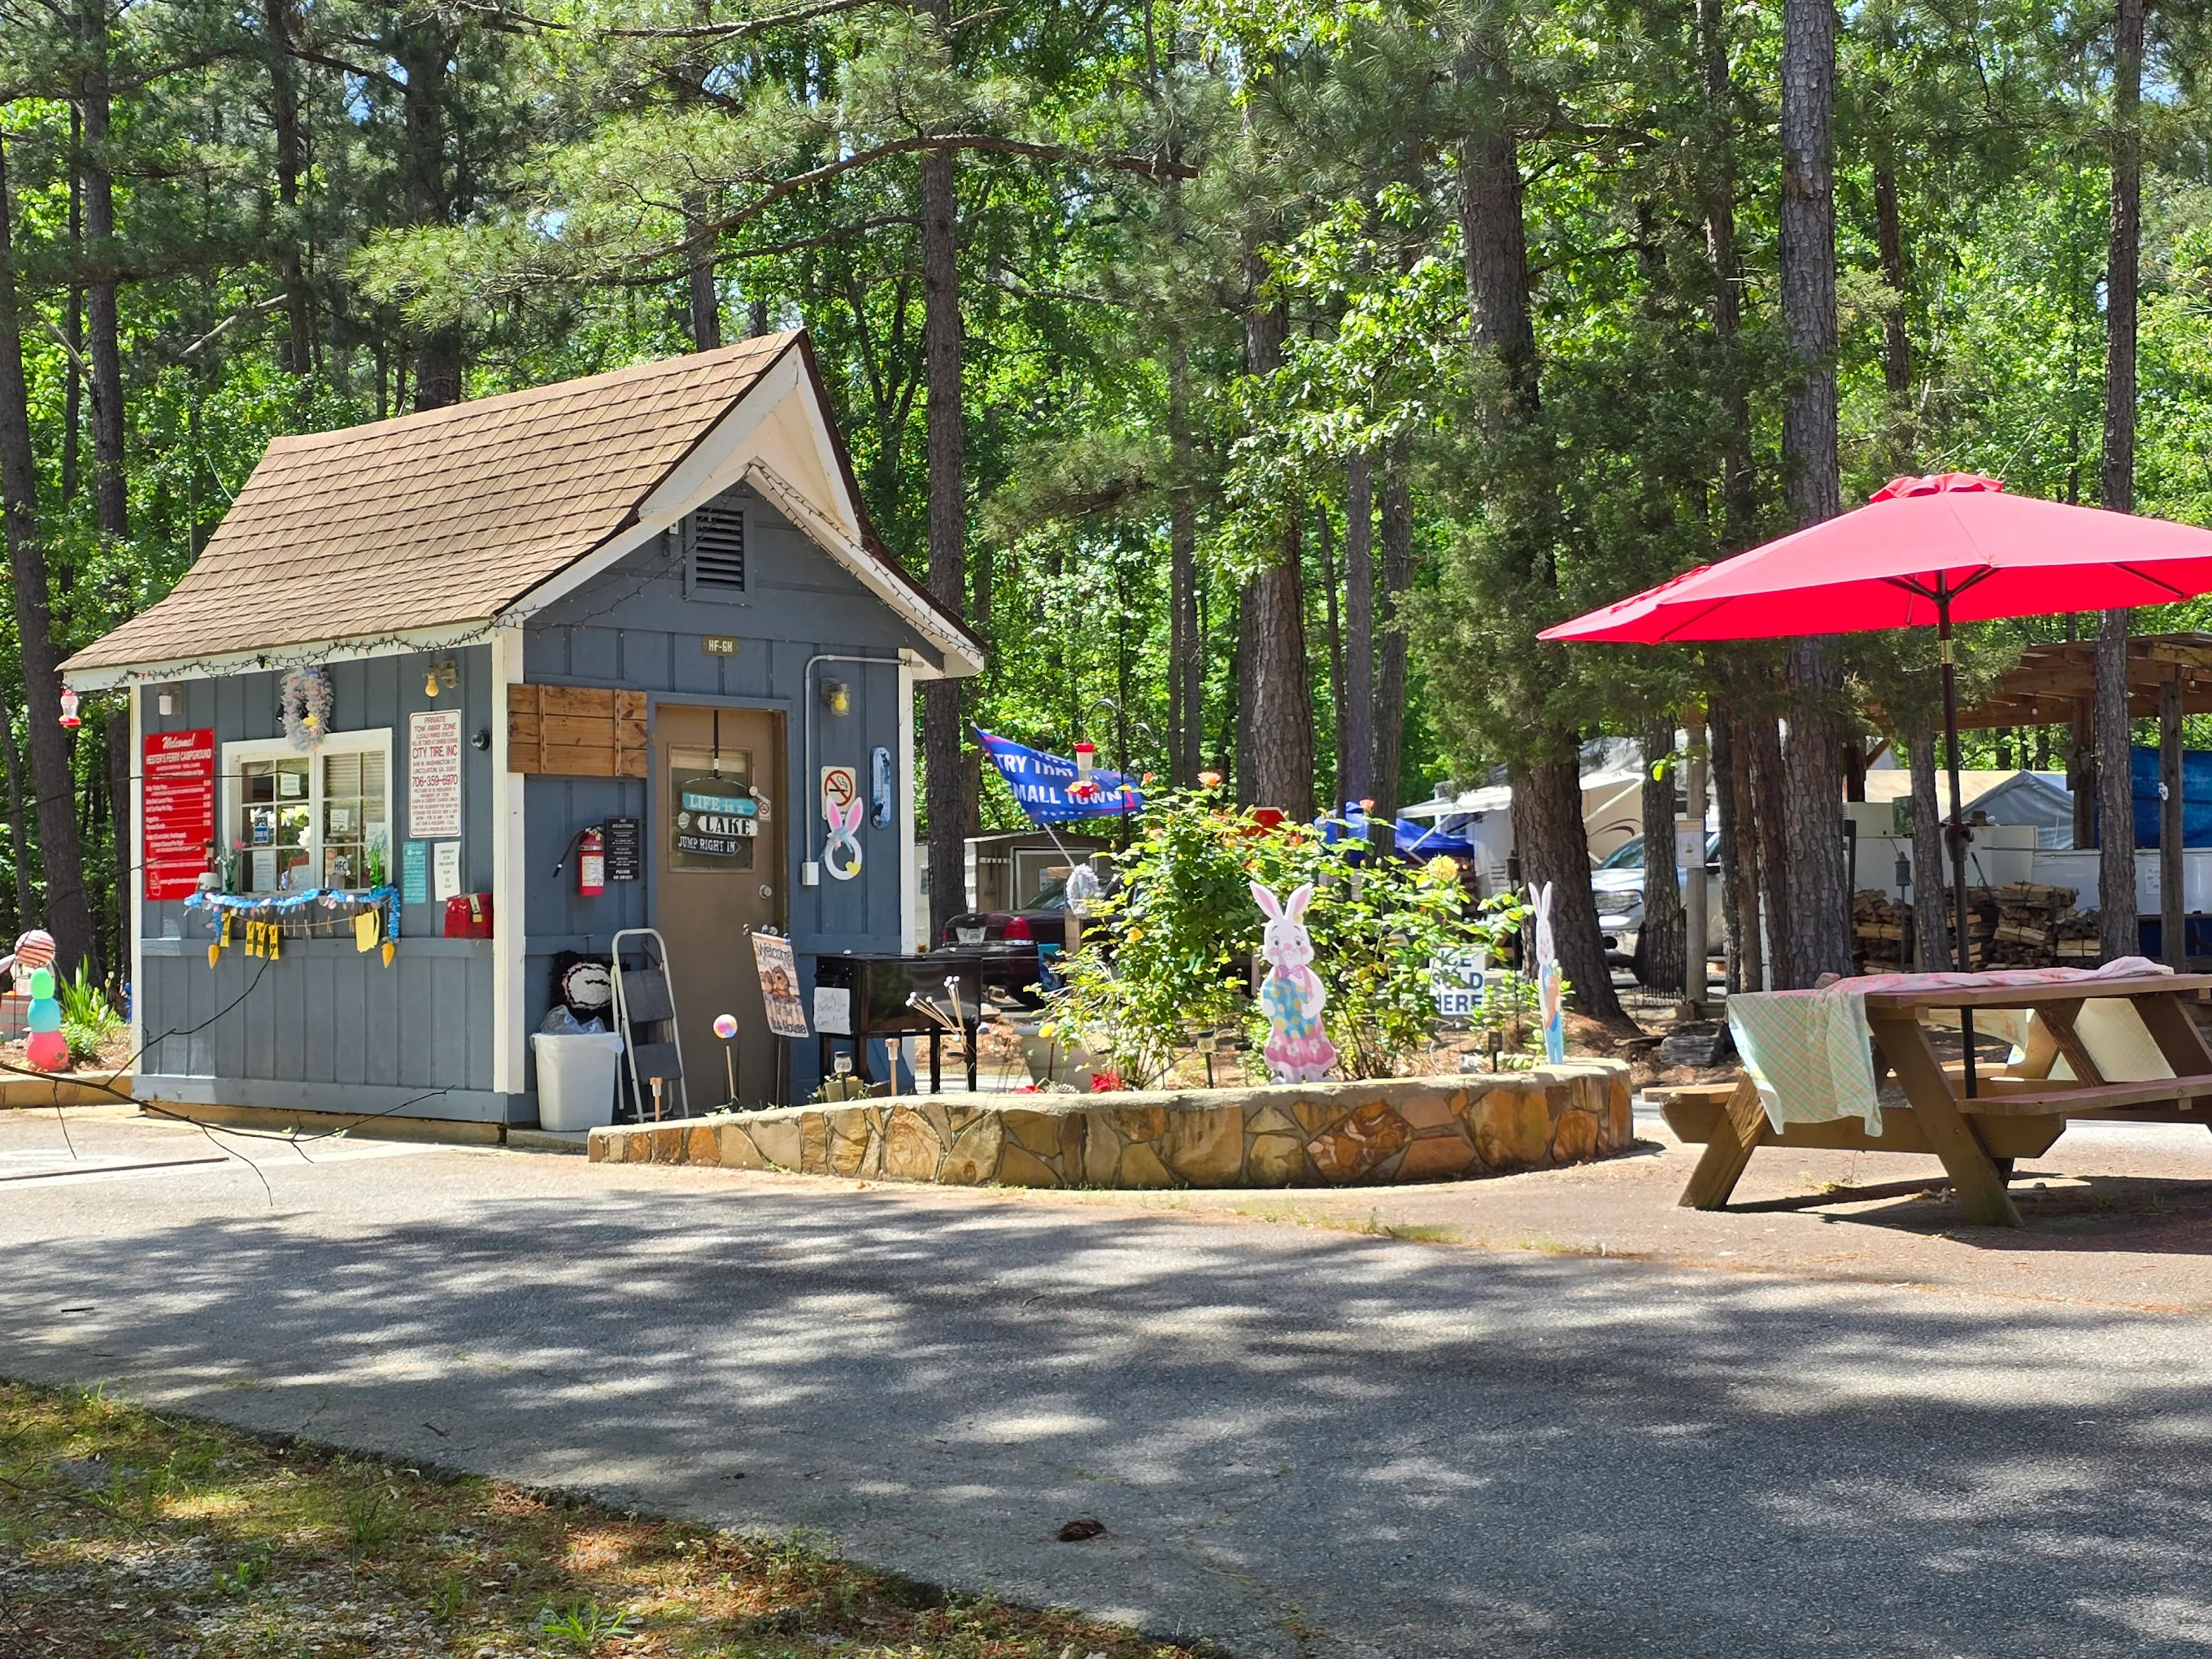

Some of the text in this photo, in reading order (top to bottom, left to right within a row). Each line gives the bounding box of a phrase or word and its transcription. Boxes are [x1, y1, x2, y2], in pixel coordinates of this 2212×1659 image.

[412, 747, 426, 759] CITY
[994, 753, 1027, 773] TRY
[412, 774, 458, 787] 706-359-6970
[1008, 782, 1060, 805] MALL
[690, 795, 721, 810] LIFE
[737, 805, 744, 814] a
[706, 816, 750, 834] LAKE
[678, 836, 735, 852] JUMP RIGHT IN
[334, 860, 348, 871] HFC
[755, 941, 792, 961] Welcome
[1441, 950, 1472, 967] IE
[1432, 972, 1483, 990] SD
